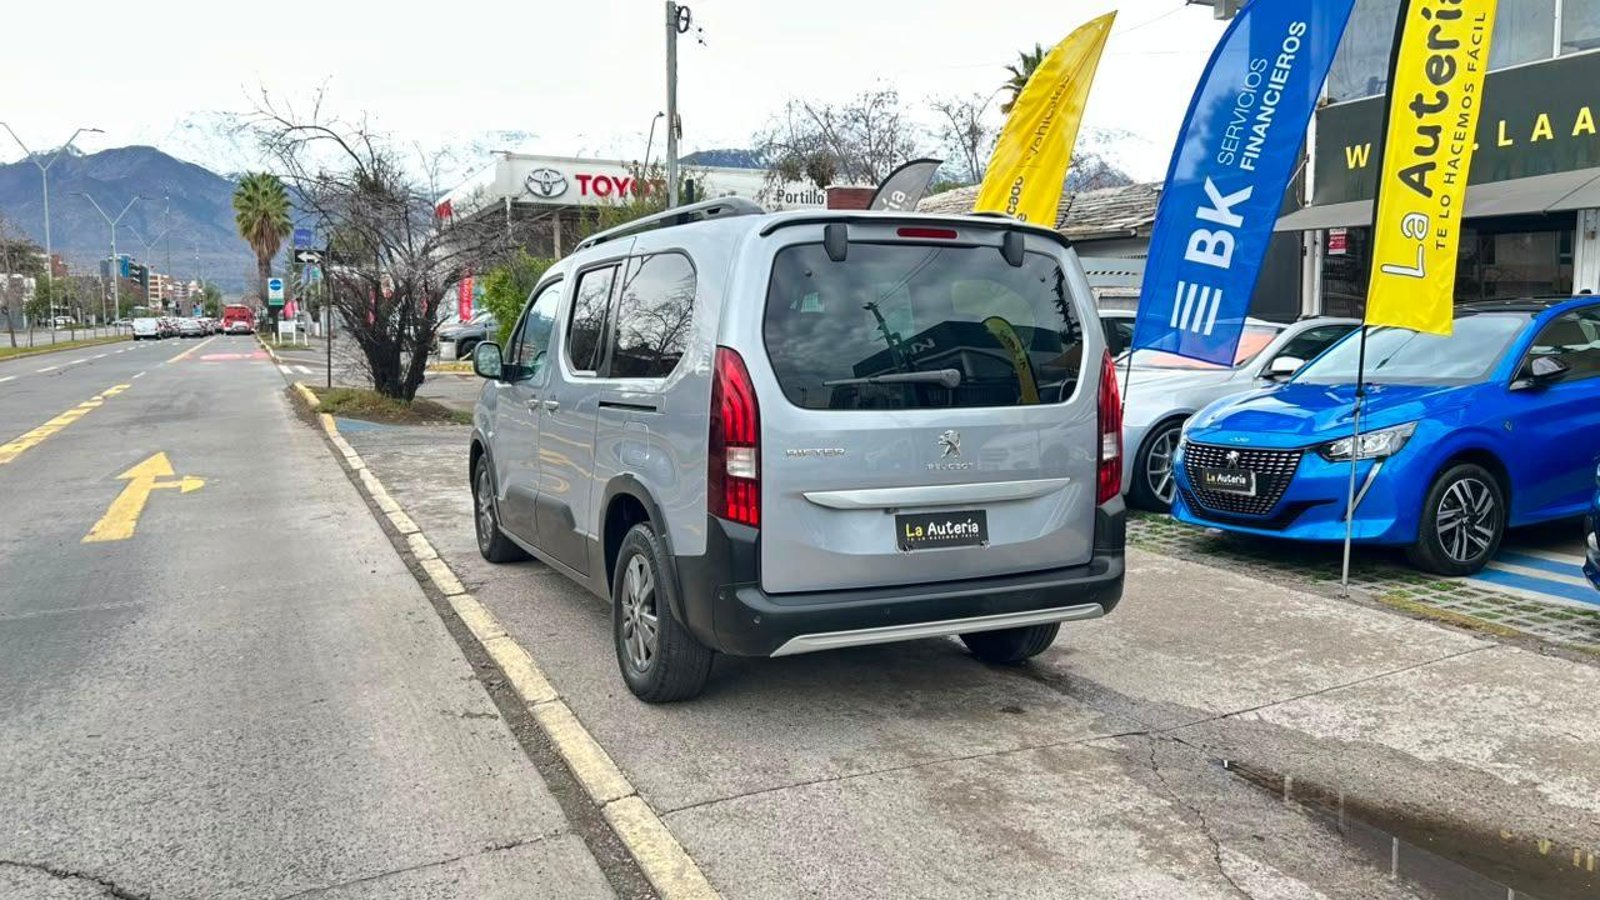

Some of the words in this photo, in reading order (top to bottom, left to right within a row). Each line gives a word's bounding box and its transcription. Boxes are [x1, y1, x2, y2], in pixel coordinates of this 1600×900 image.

[1467, 12, 1486, 72] FÁCIL
[1217, 58, 1268, 166] SERVICIOS
[1239, 21, 1307, 171] FINANCIEROS
[1444, 83, 1475, 184] HACEMOS
[777, 188, 826, 205] Portillo
[1184, 175, 1254, 269] BK
[1439, 194, 1451, 219] LO
[1381, 212, 1429, 278] La
[1435, 228, 1448, 250] TE
[905, 523, 923, 538] La
[927, 518, 980, 536] Autería
